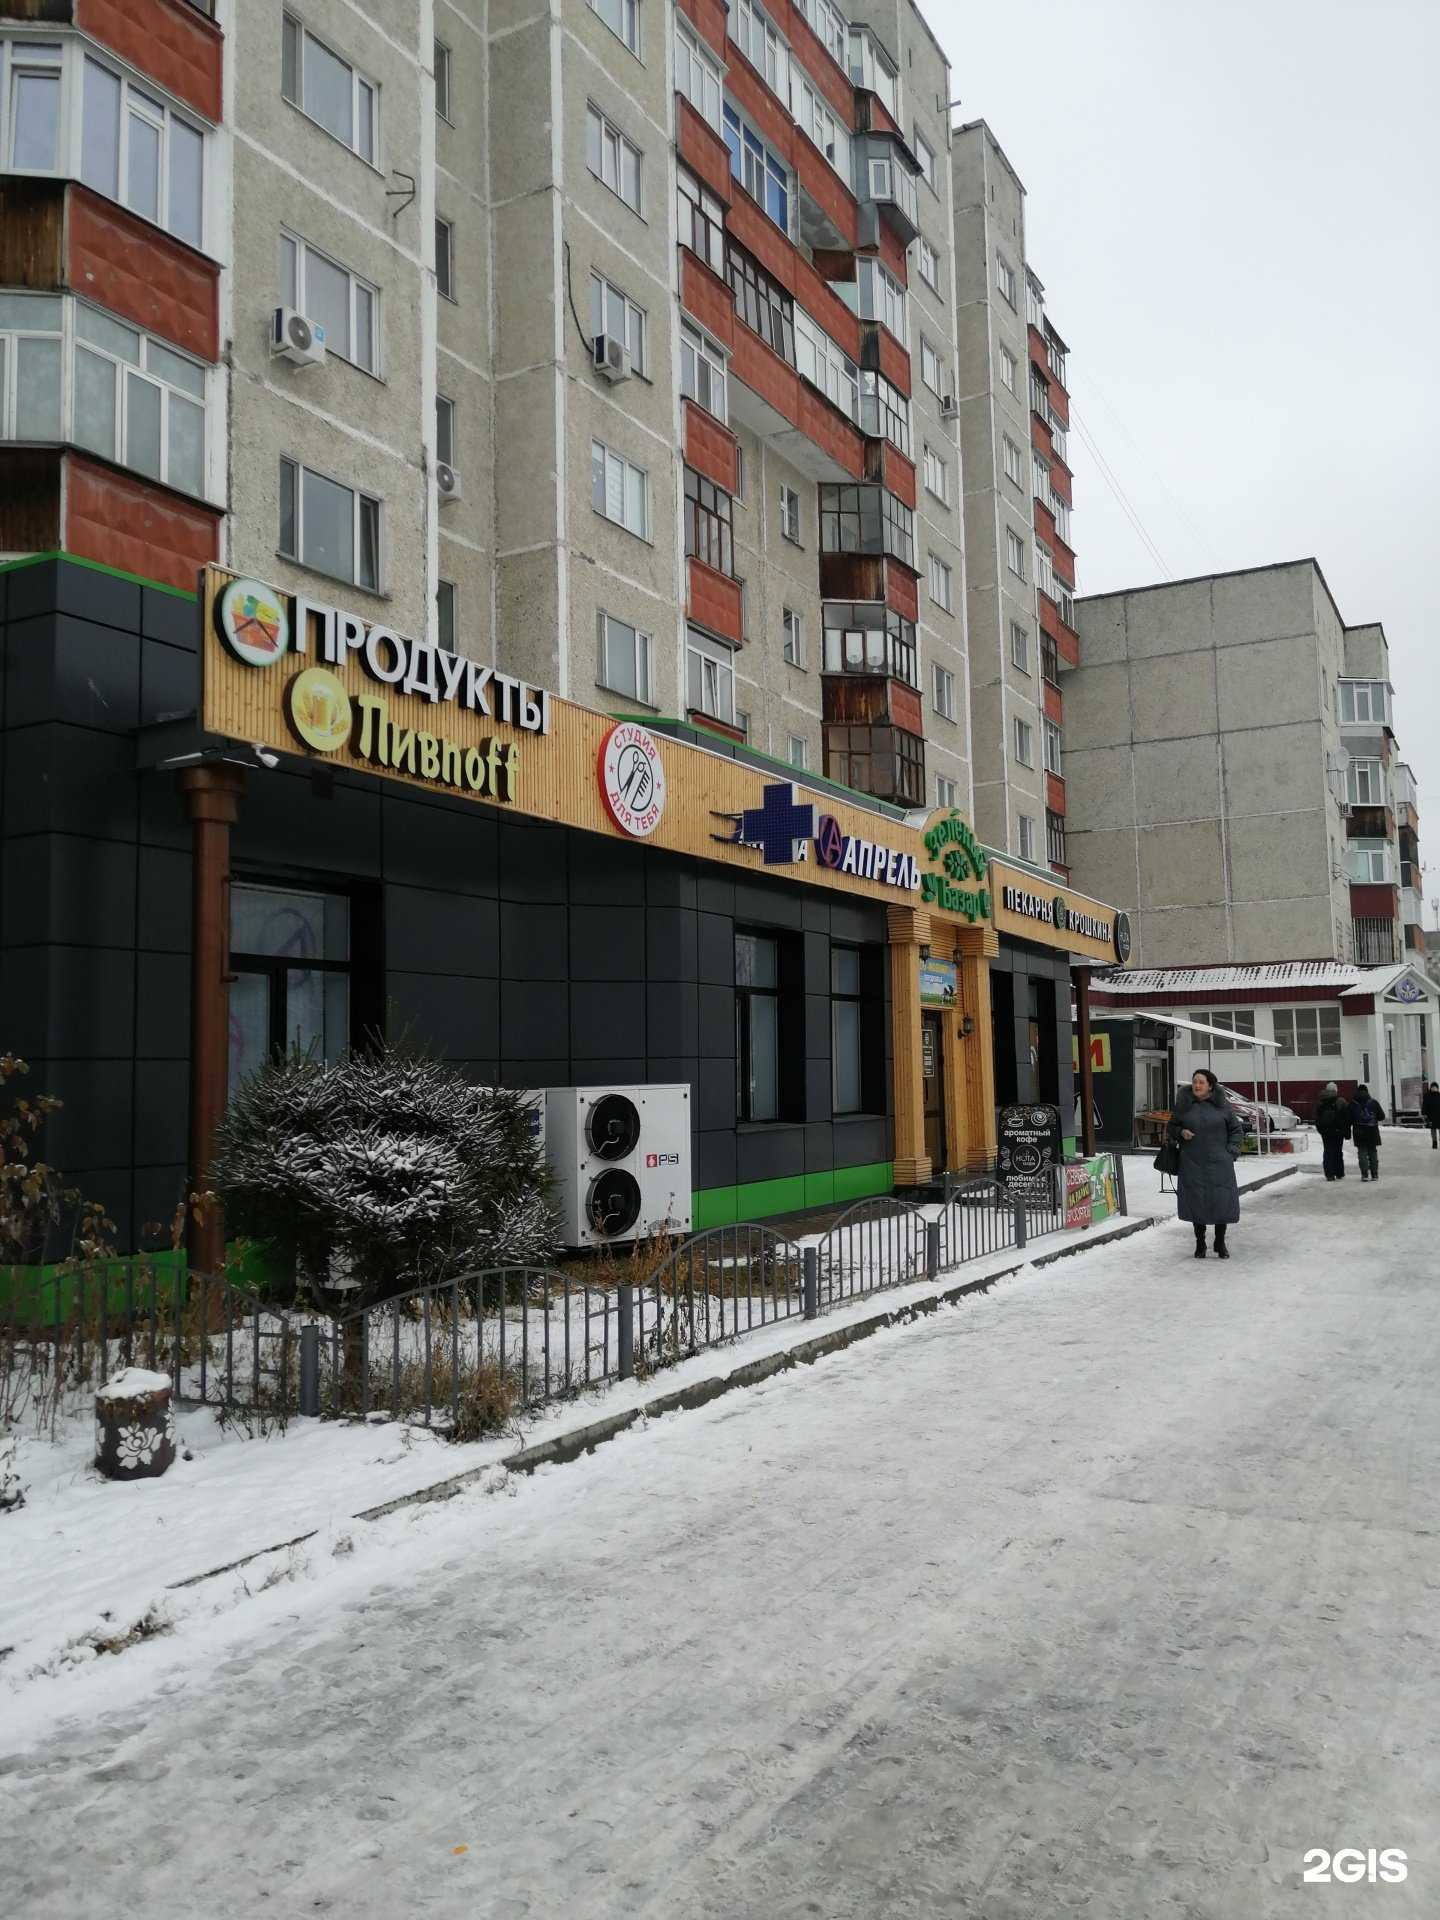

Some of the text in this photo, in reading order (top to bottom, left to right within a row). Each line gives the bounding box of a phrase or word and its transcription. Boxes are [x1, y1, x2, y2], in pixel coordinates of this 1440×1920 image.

[294, 596, 550, 735] ПРОДУКТЫ
[614, 727, 657, 760] СТУДИЯ
[609, 791, 660, 830] ДЛЯ ТЕБЯ
[840, 836, 921, 890] АПРЕЛЬ
[1005, 886, 1054, 923] ПЕКАРНЯ
[1068, 909, 1112, 943] КРОШКИНА
[1004, 1129, 1051, 1138] ароматный
[1016, 1135, 1038, 1144] кофе
[658, 1153, 679, 1166] PSI
